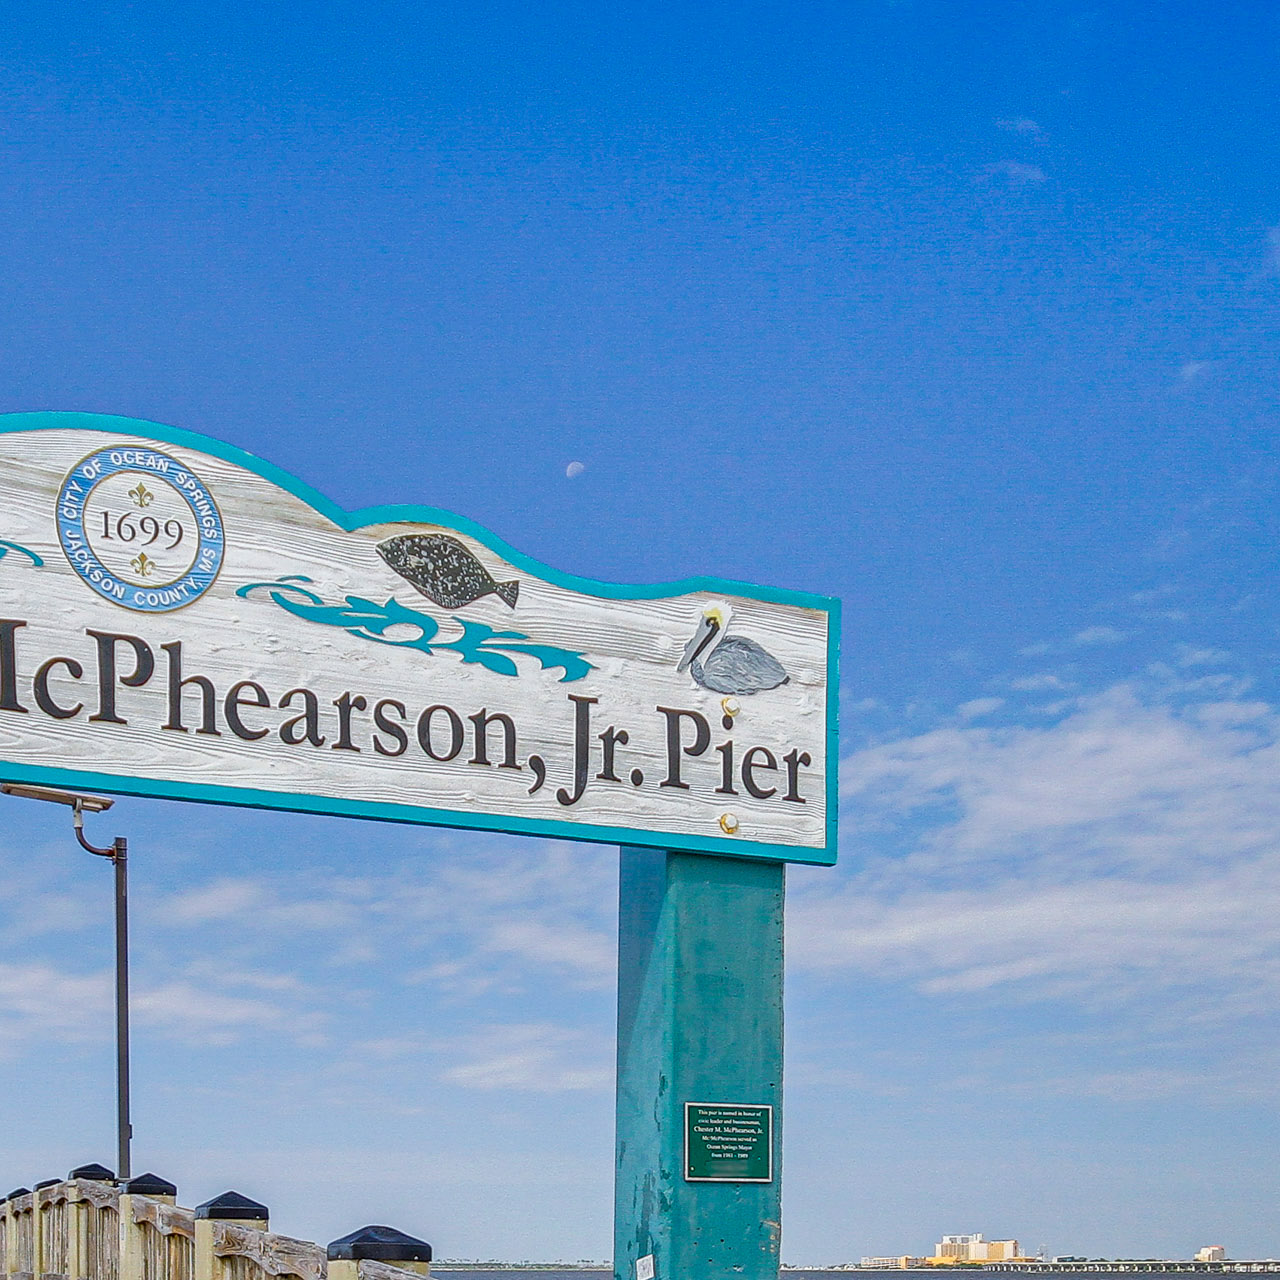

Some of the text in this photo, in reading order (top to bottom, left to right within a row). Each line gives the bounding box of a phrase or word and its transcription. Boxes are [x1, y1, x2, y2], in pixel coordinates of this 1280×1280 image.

[62, 451, 218, 540] CITY OF OCEAN SPRINGS
[99, 510, 184, 550] 1699
[65, 530, 216, 607] JACKSON COUNTY, MS
[556, 693, 644, 806] Jr.
[656, 705, 812, 805] Pier
